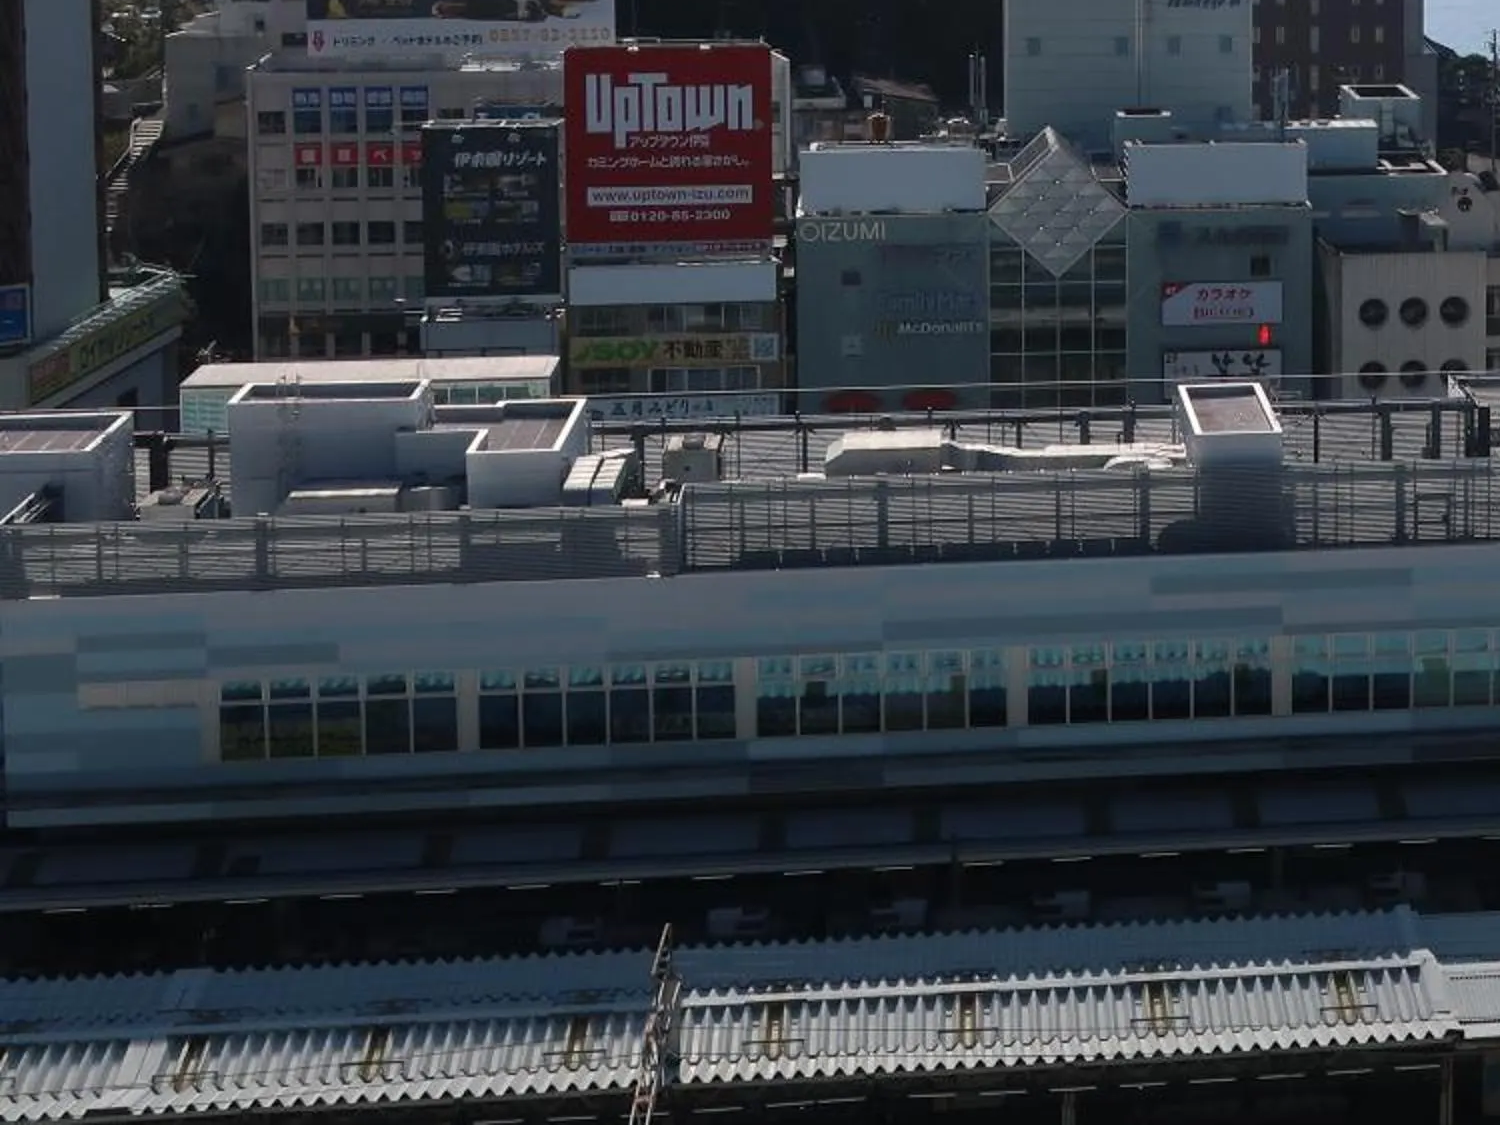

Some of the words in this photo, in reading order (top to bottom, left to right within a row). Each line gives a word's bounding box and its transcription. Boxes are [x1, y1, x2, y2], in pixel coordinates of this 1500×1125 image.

[591, 187, 750, 204] www.uptown-izu.com
[800, 221, 886, 242] OIZUMI
[1196, 287, 1254, 301] カラオケ
